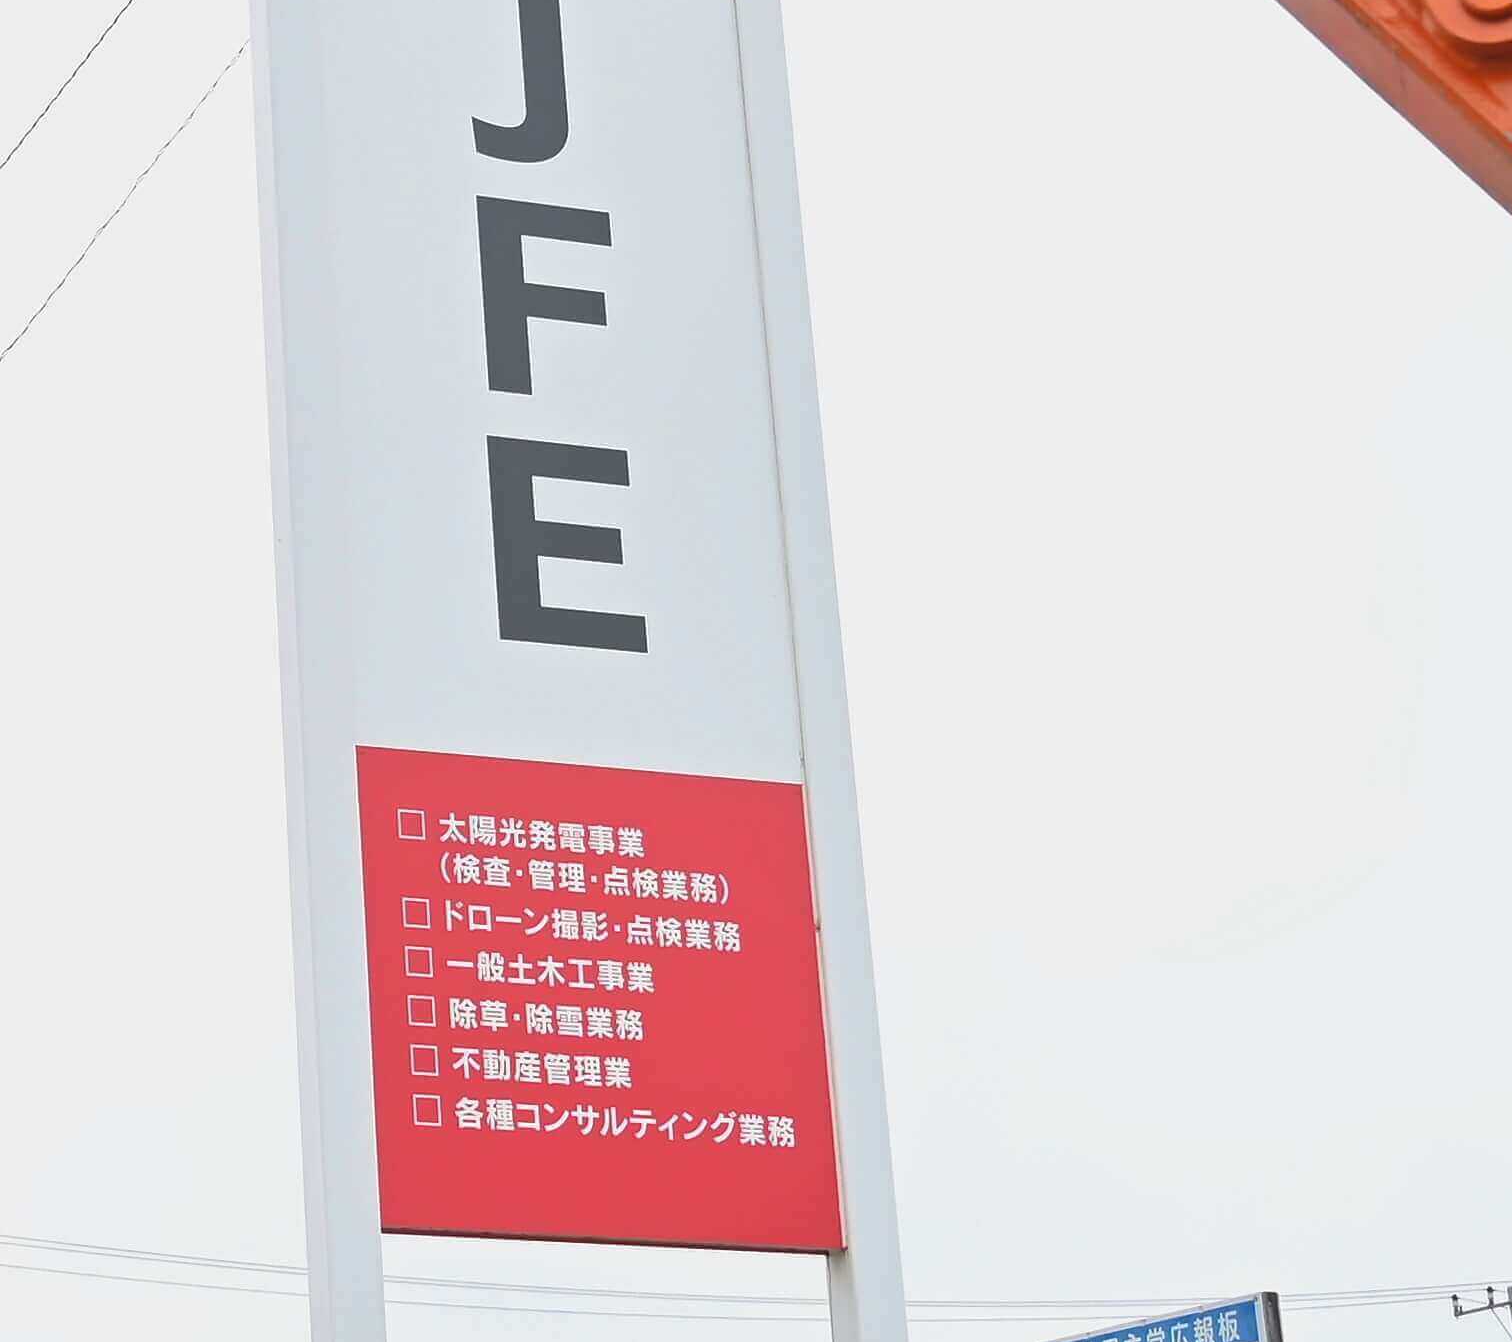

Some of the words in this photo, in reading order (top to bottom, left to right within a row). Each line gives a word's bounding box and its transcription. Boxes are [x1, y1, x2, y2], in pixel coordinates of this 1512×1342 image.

[438, 811, 646, 859] 太陽光発電事業
[443, 899, 743, 954] ドローン撮影・点検業務
[446, 951, 656, 994] 一般土木工事業
[448, 997, 645, 1041] 除草・除雪業務
[452, 1046, 633, 1089] 不動産管理業
[454, 1096, 797, 1149] 各種コンサルティング業務
